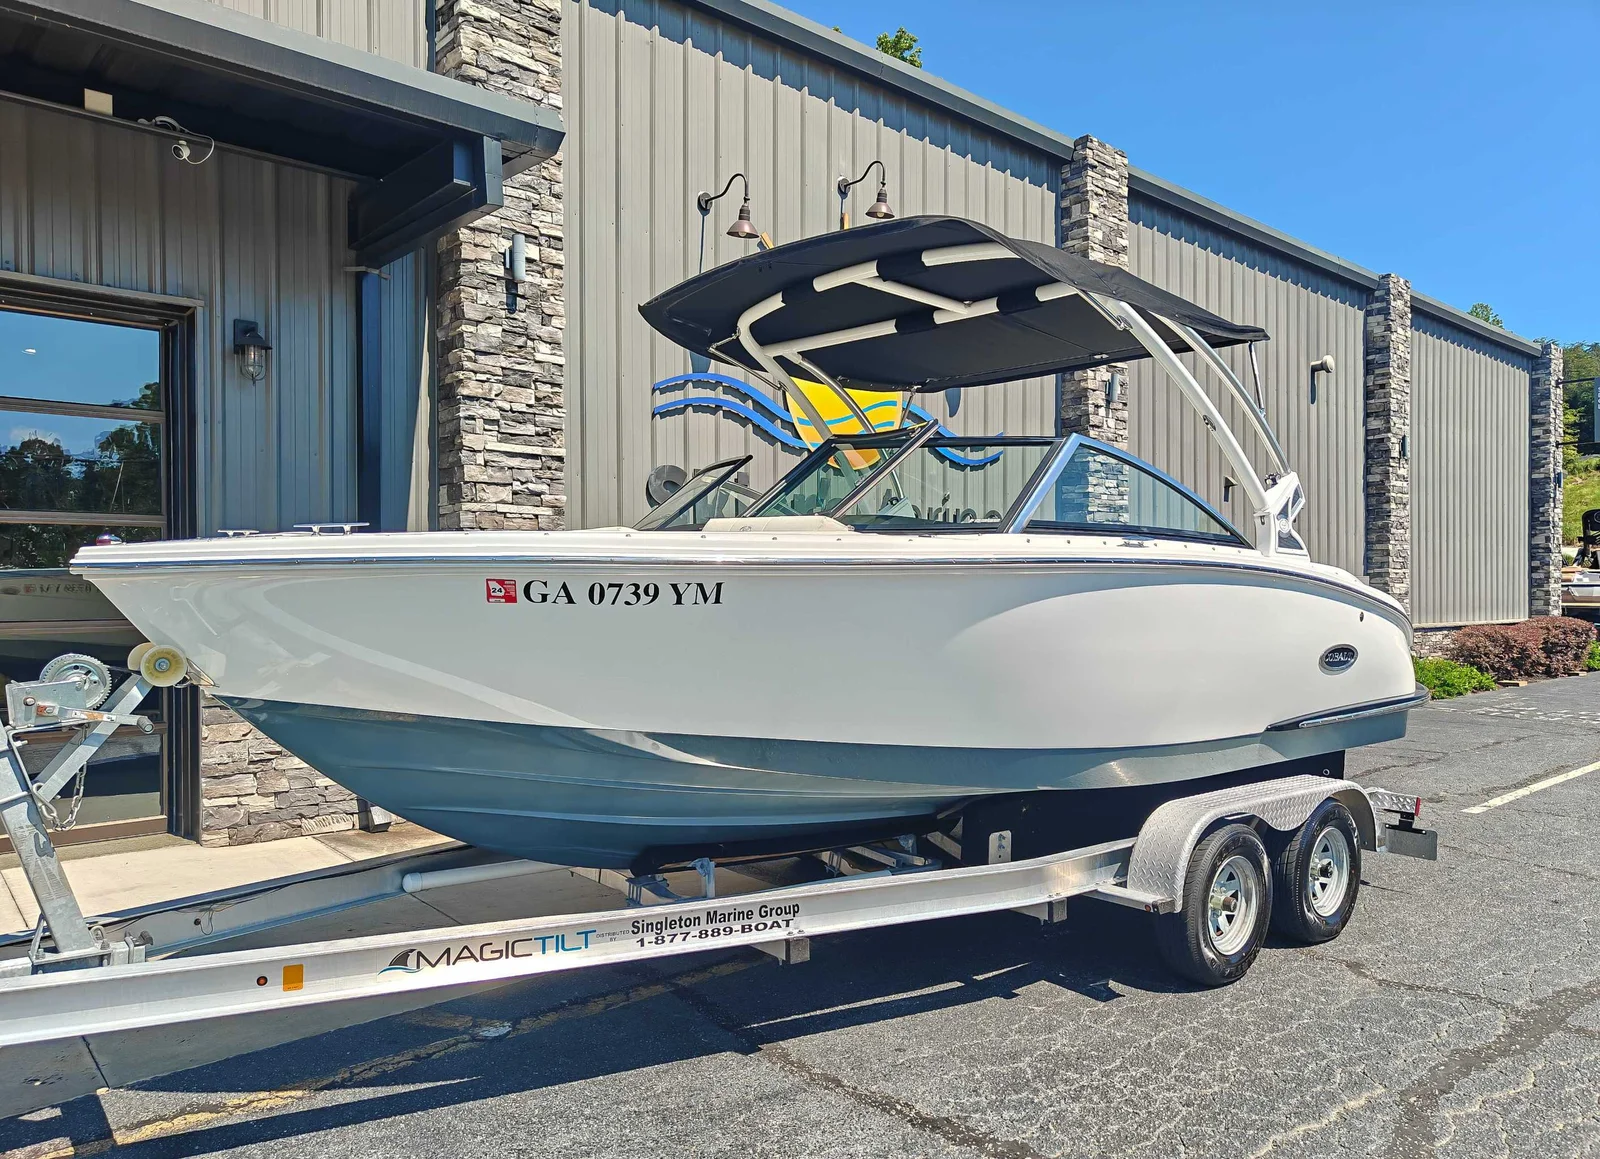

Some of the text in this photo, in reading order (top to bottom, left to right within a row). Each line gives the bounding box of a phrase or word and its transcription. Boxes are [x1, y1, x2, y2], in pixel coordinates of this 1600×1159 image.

[523, 579, 577, 605] GA
[588, 582, 660, 606] 0739
[668, 581, 725, 606] YM
[631, 903, 800, 936] Singleton Marine Group
[636, 919, 794, 947] 1-877-889-BOAT
[596, 930, 630, 939] DISTRIBUTED
[416, 929, 597, 969] MAGICTILT
